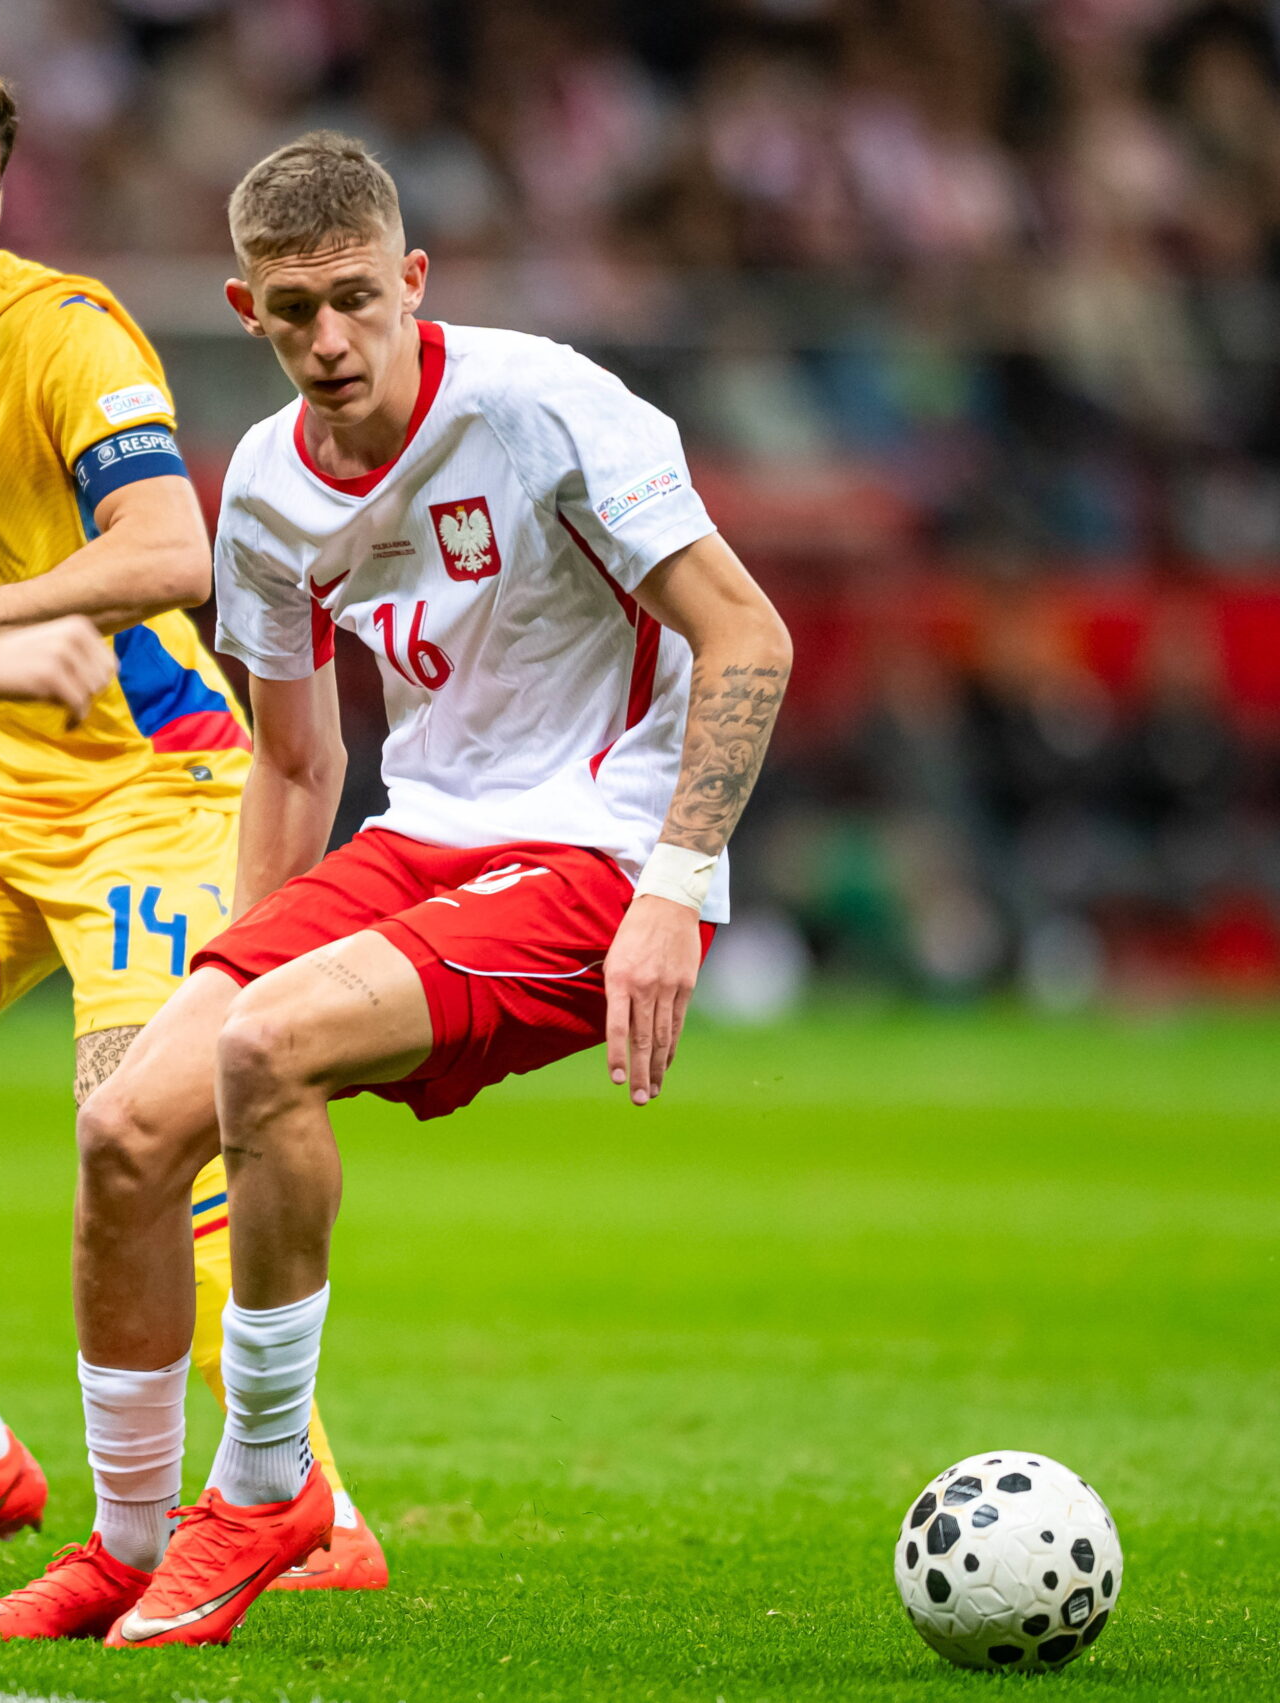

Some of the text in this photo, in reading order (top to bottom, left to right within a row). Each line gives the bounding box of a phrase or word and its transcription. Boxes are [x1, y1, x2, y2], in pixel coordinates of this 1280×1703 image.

[118, 435, 178, 454] RESPEC
[601, 470, 679, 522] FOUNDATION
[373, 600, 455, 692] 16
[107, 884, 188, 978] 14
